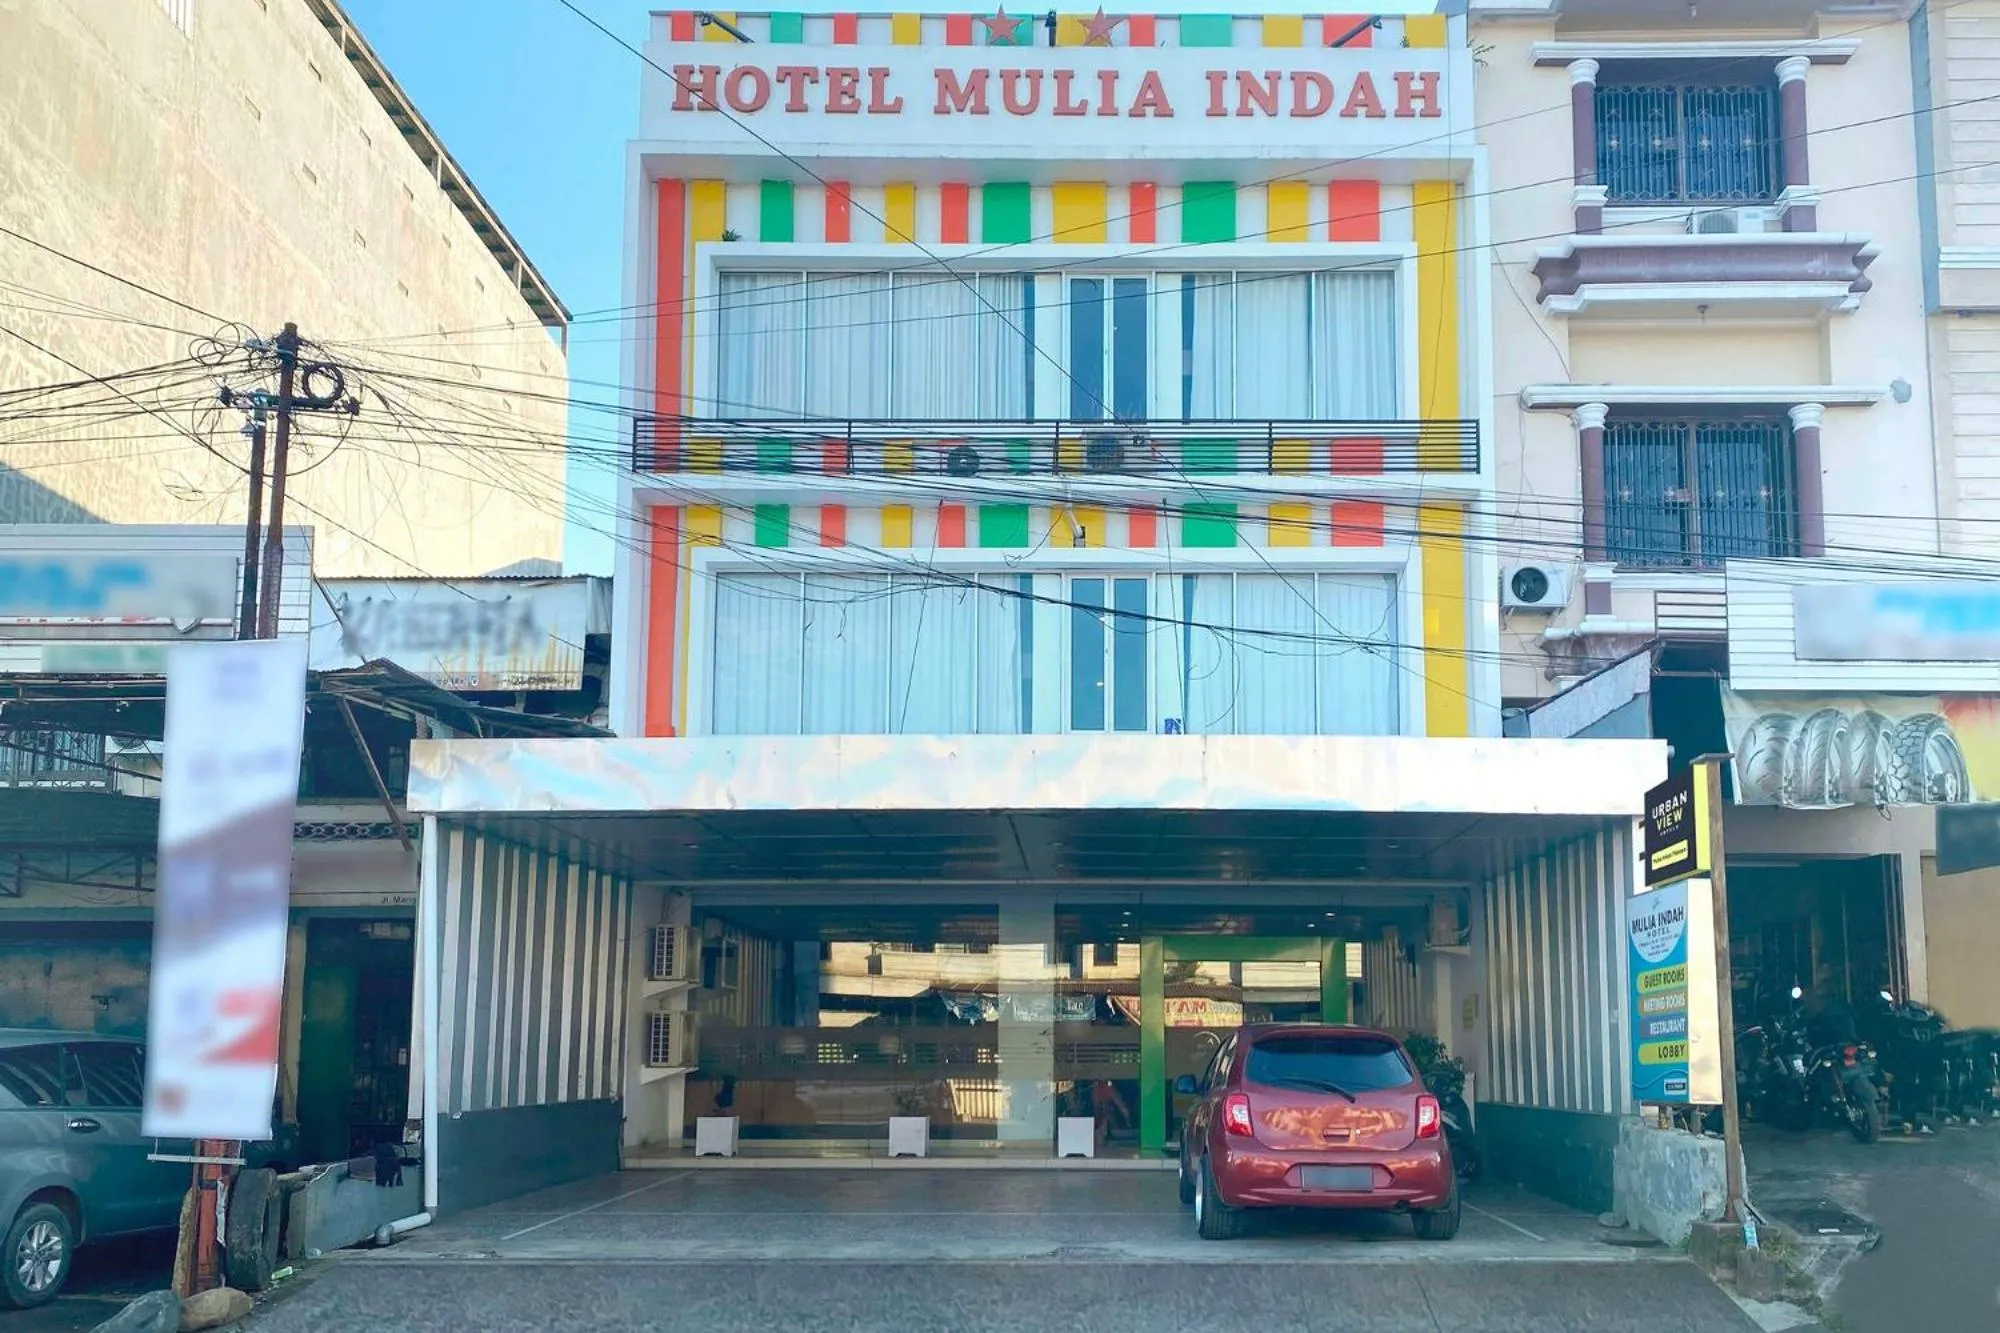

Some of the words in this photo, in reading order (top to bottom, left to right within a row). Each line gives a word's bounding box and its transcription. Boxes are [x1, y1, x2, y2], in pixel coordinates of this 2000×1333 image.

[671, 64, 904, 114] HOTEL
[933, 68, 1175, 118] MULIA
[1205, 70, 1443, 119] INDAH
[1652, 791, 1687, 819] URBAN
[1656, 808, 1683, 831] VIEW
[1632, 914, 1656, 934] MULIA
[1658, 906, 1684, 926] INDAH
[1644, 974, 1662, 988] GUEST
[1663, 968, 1685, 984] ROOMS
[1666, 993, 1685, 1008] ROOMS
[1650, 1018, 1685, 1034] RESTAURANT
[1658, 1044, 1685, 1059] LOBBY
